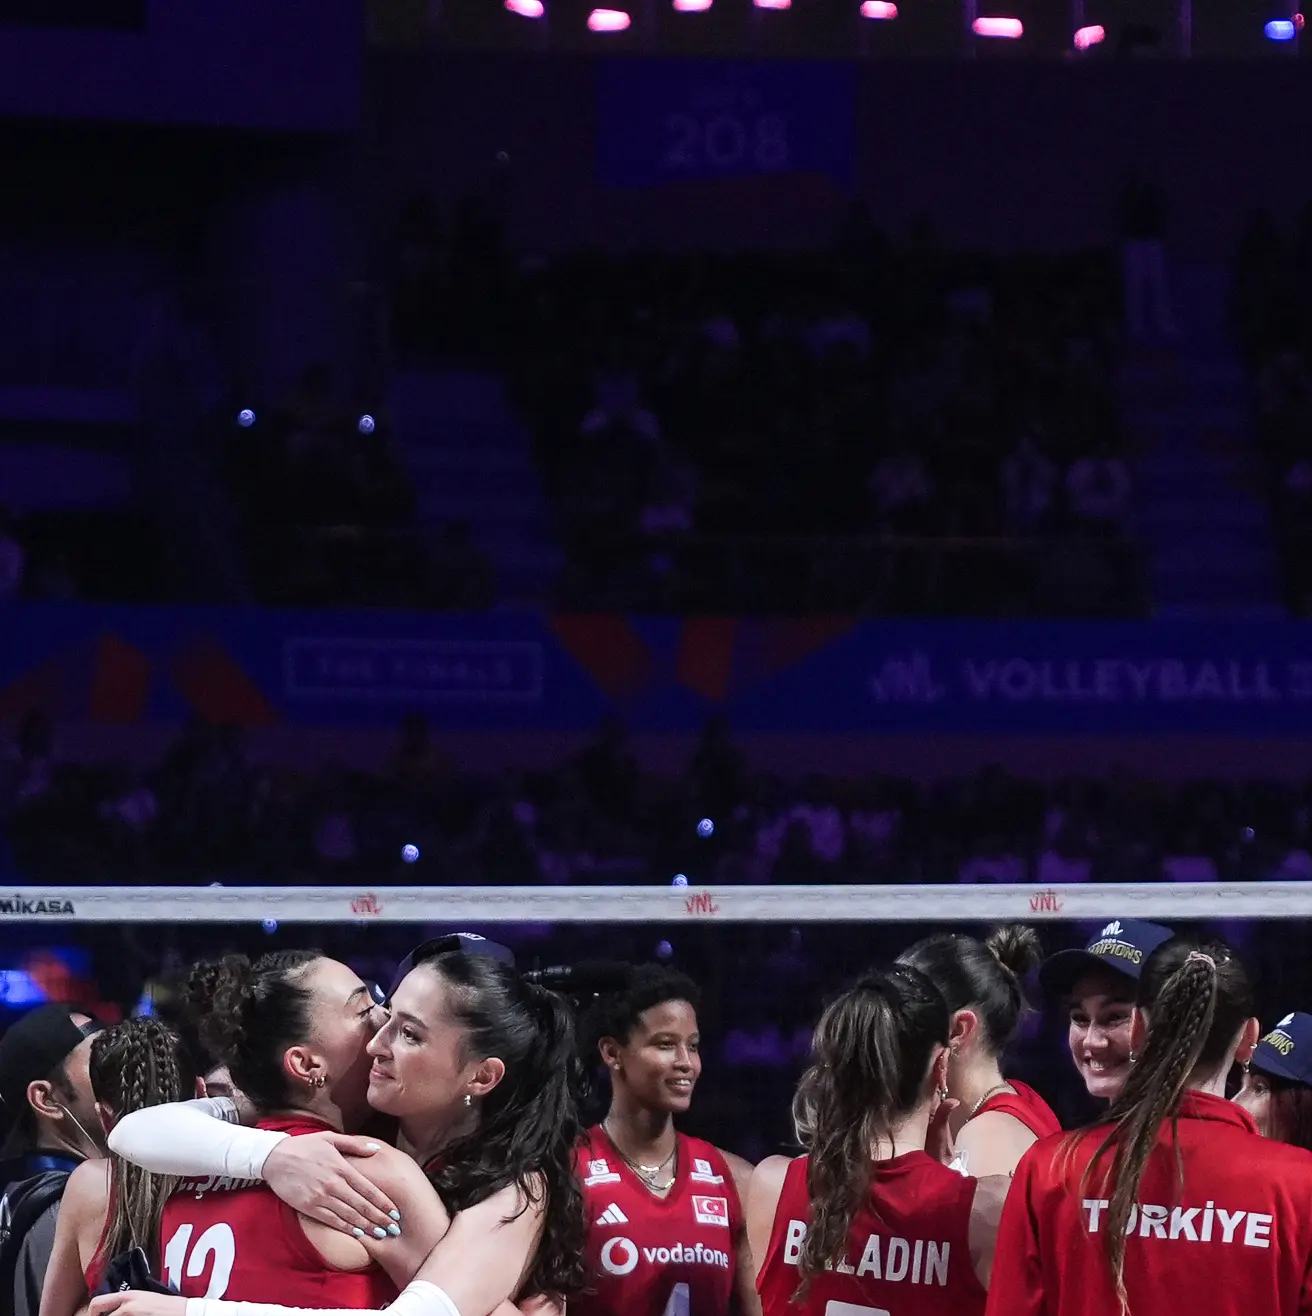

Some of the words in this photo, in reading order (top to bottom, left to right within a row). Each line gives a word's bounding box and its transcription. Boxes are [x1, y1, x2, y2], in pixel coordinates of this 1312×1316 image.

[660, 113, 791, 170] 208
[963, 656, 1284, 701] VOLLEYBALL
[1089, 944, 1142, 965] AMPIONS
[642, 1242, 730, 1270] vodafone
[783, 1217, 951, 1287] BLADIN
